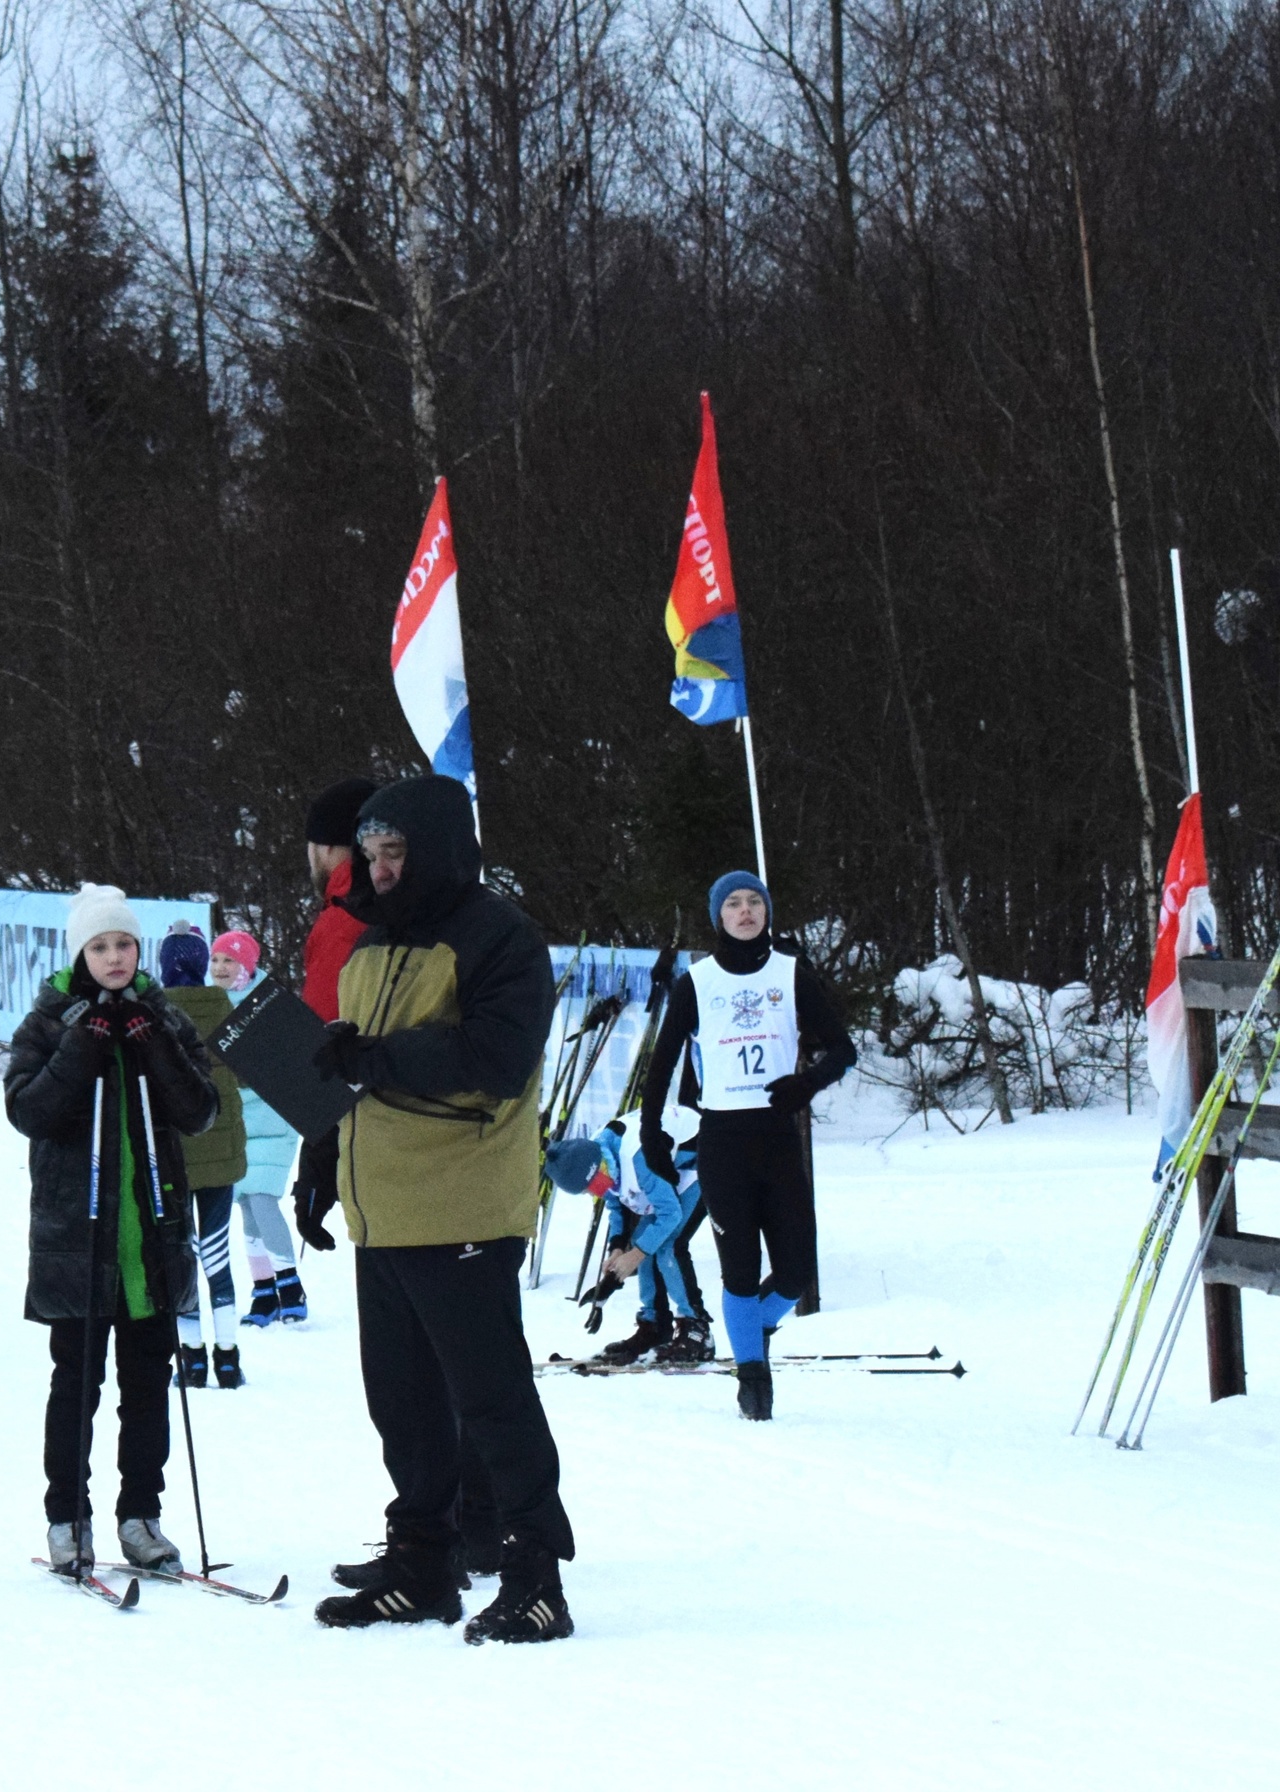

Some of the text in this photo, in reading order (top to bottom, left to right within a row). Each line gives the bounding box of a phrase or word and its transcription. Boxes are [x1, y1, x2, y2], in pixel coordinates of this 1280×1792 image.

[737, 1044, 766, 1076] 12
[151, 1170, 163, 1208] SPORT
[1139, 1189, 1169, 1262] FISCHER
[1154, 1198, 1184, 1273] FISCHER
